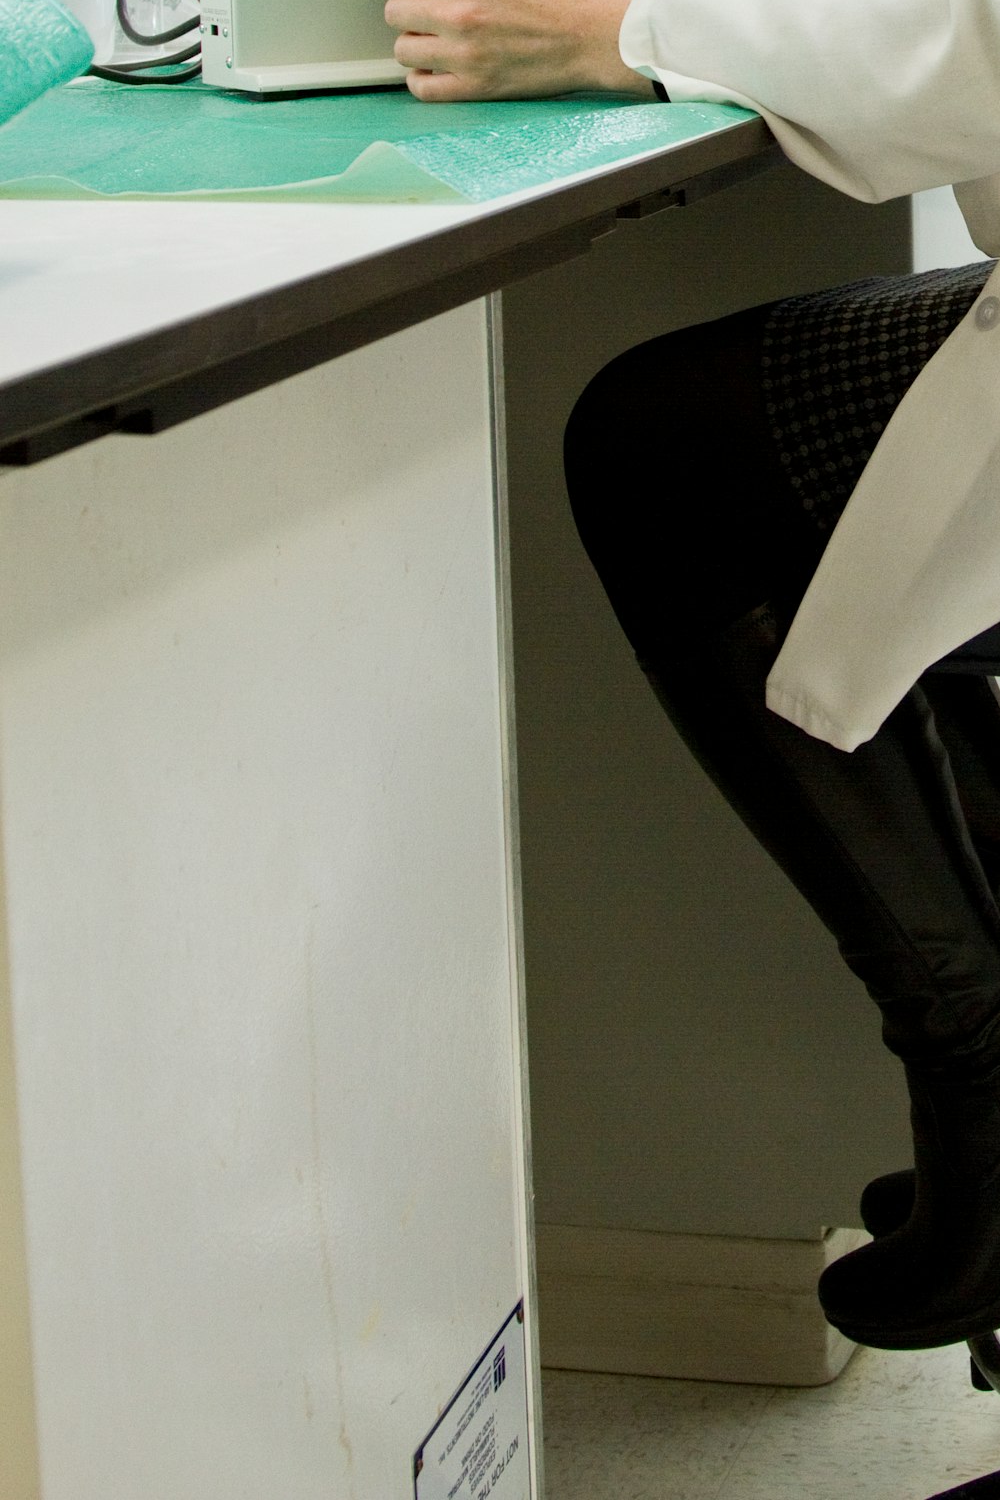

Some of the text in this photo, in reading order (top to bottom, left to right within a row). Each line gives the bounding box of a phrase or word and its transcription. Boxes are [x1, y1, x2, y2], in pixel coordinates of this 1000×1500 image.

[462, 1413, 495, 1468] FOOD OR DRINK
[506, 1435, 519, 1467] NOT
[491, 1457, 505, 1487] FOR
